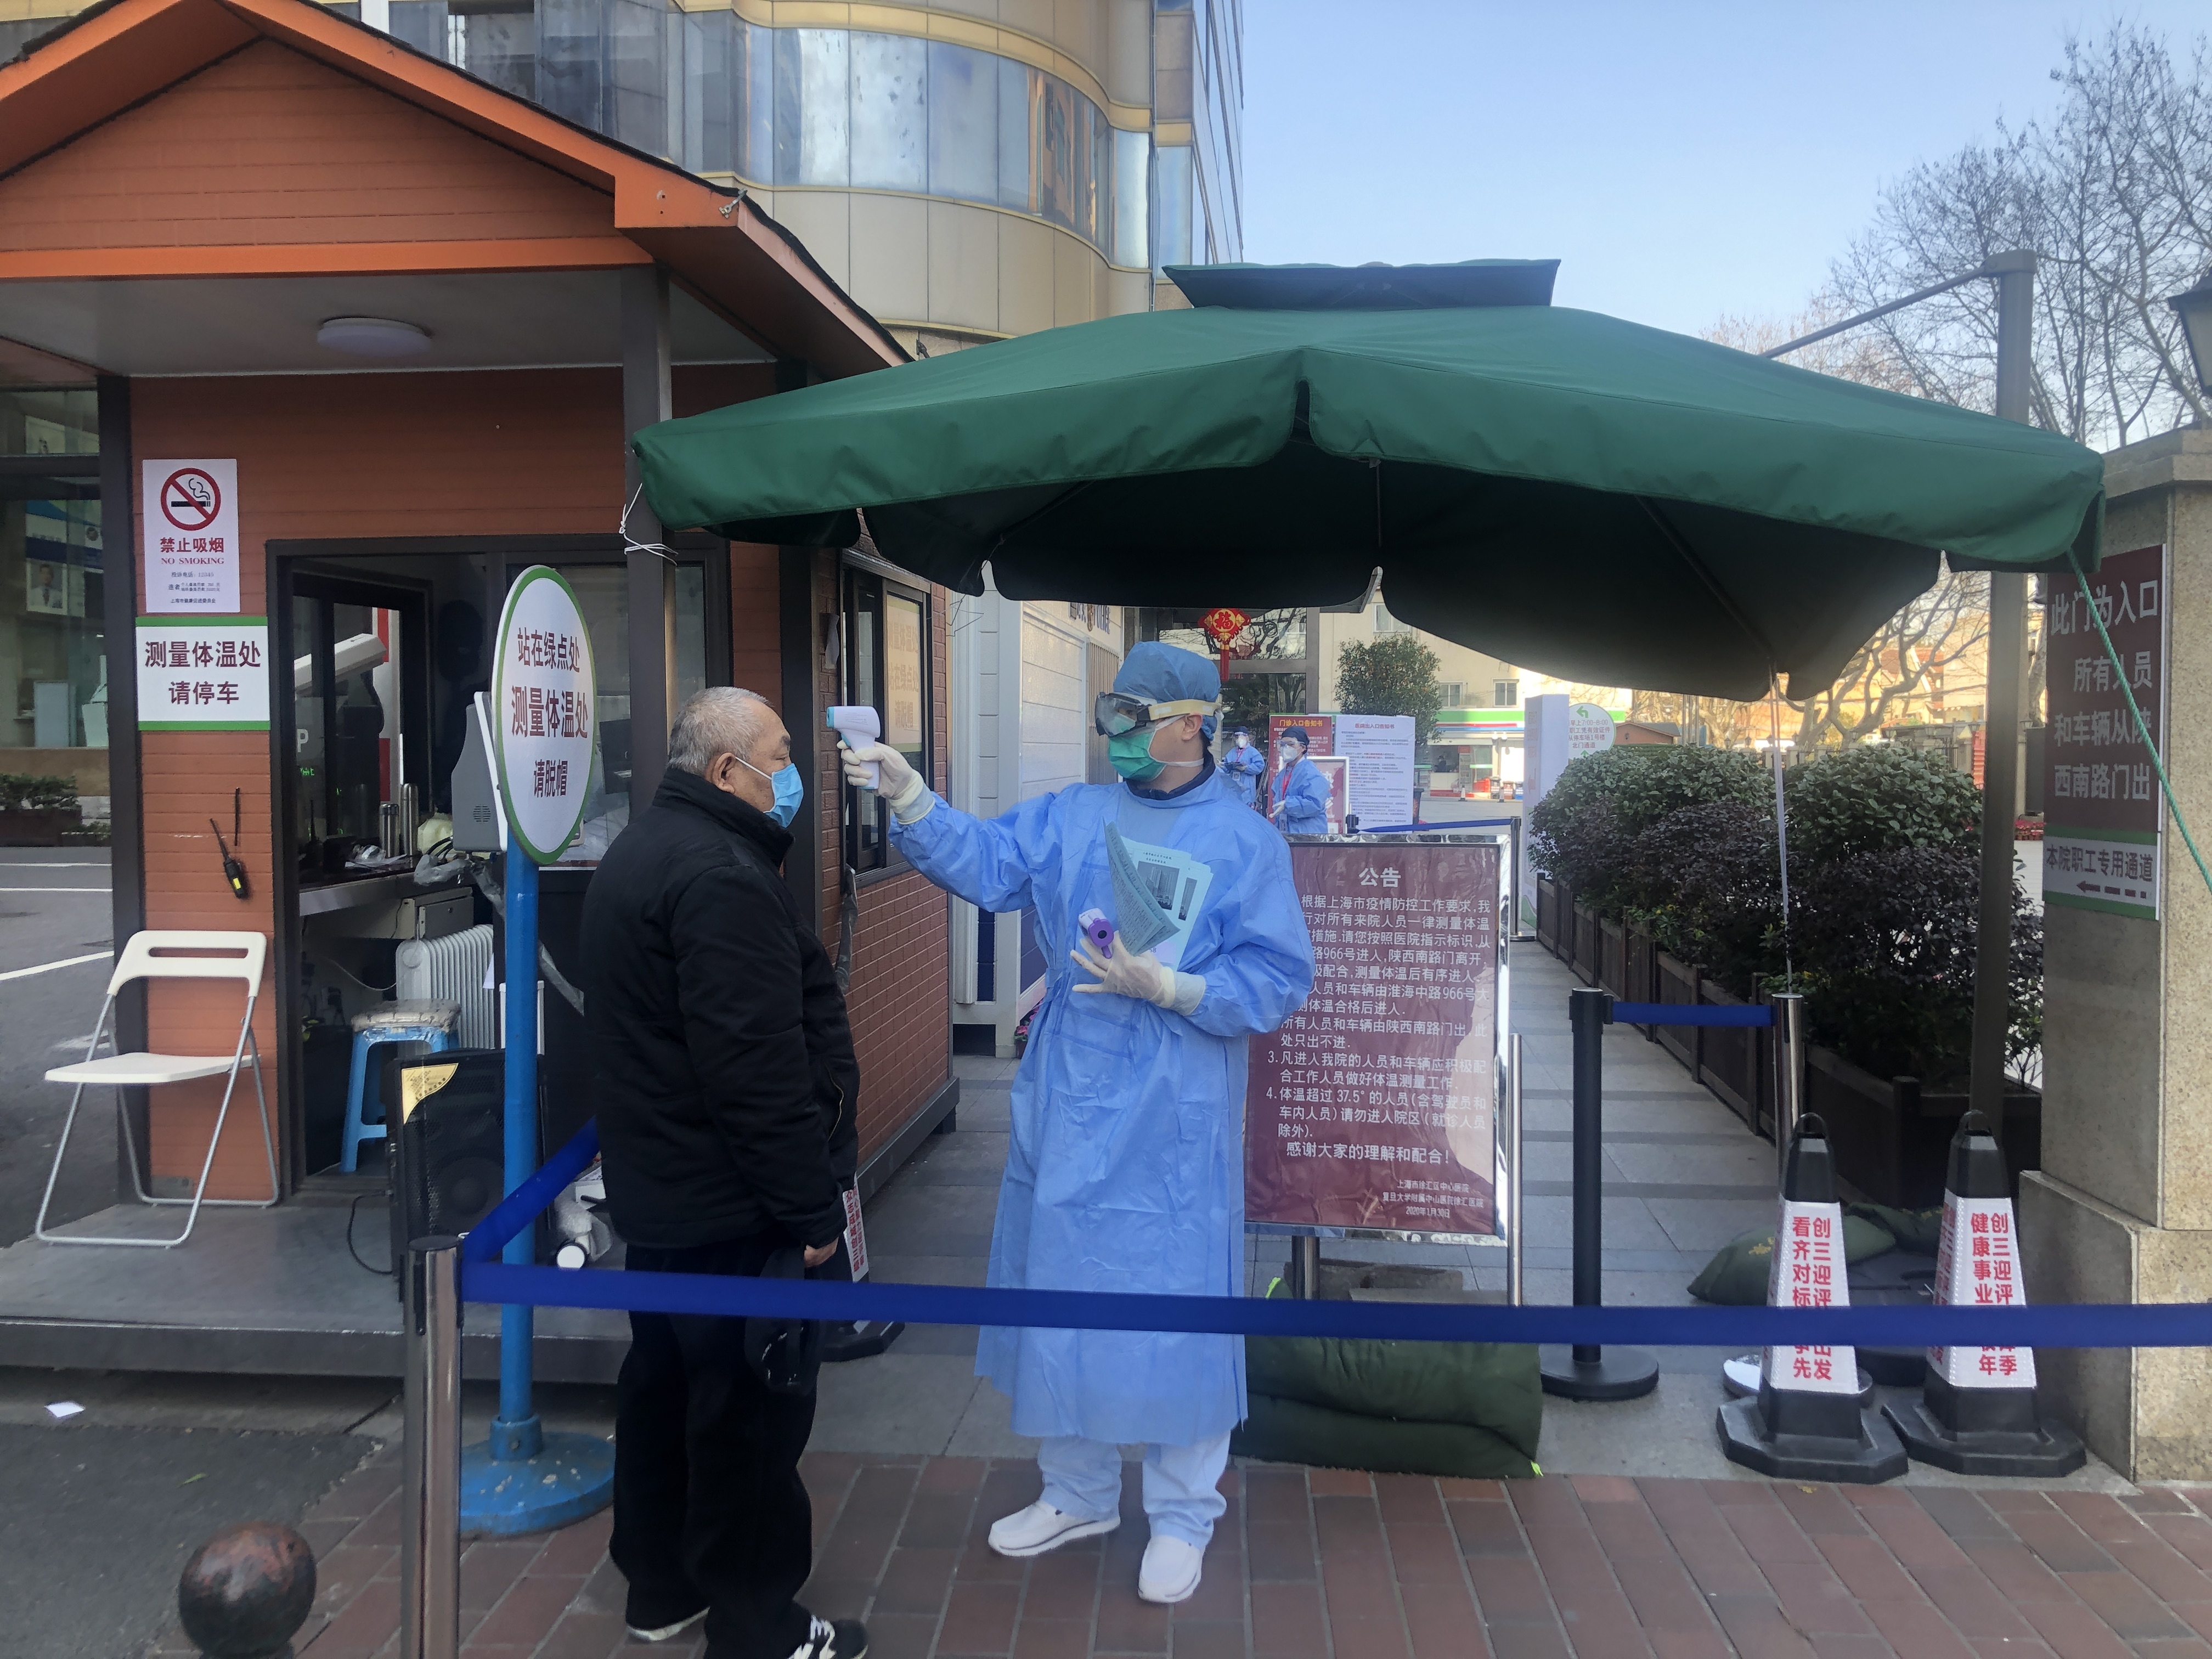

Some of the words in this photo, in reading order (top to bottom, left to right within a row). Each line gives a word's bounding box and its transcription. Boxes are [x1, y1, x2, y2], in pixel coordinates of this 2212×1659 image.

[160, 537, 224, 553] 禁止吸烟
[1214, 611, 1234, 629] 福
[2051, 579, 2158, 636] 此门为入口
[144, 640, 261, 668] 测量体温处
[517, 627, 580, 673] 站在绿点处
[2073, 651, 2153, 692] 所有人员
[168, 680, 240, 706] 请停车
[511, 686, 589, 740] 测量体温处
[1279, 719, 1323, 727] 门诊入口告知书
[2053, 707, 2152, 747] 和车辆从陕
[533, 759, 568, 799] 请脱帽
[2054, 763, 2150, 801] 西南路门出
[2046, 844, 2153, 882] 本院职工专用通道
[1358, 867, 1402, 888] 公告
[1302, 911, 1491, 930] 行对所有来院人员一律测量体温
[1310, 980, 1490, 1002] 人员和车辆由淮海中路966号大
[1397, 1179, 1470, 1193] 上海市徐汇区中心医院
[1383, 1191, 1484, 1209] 复旦大学附属中山医院徐汇医院
[1406, 1206, 1451, 1219] 2020年1月30日
